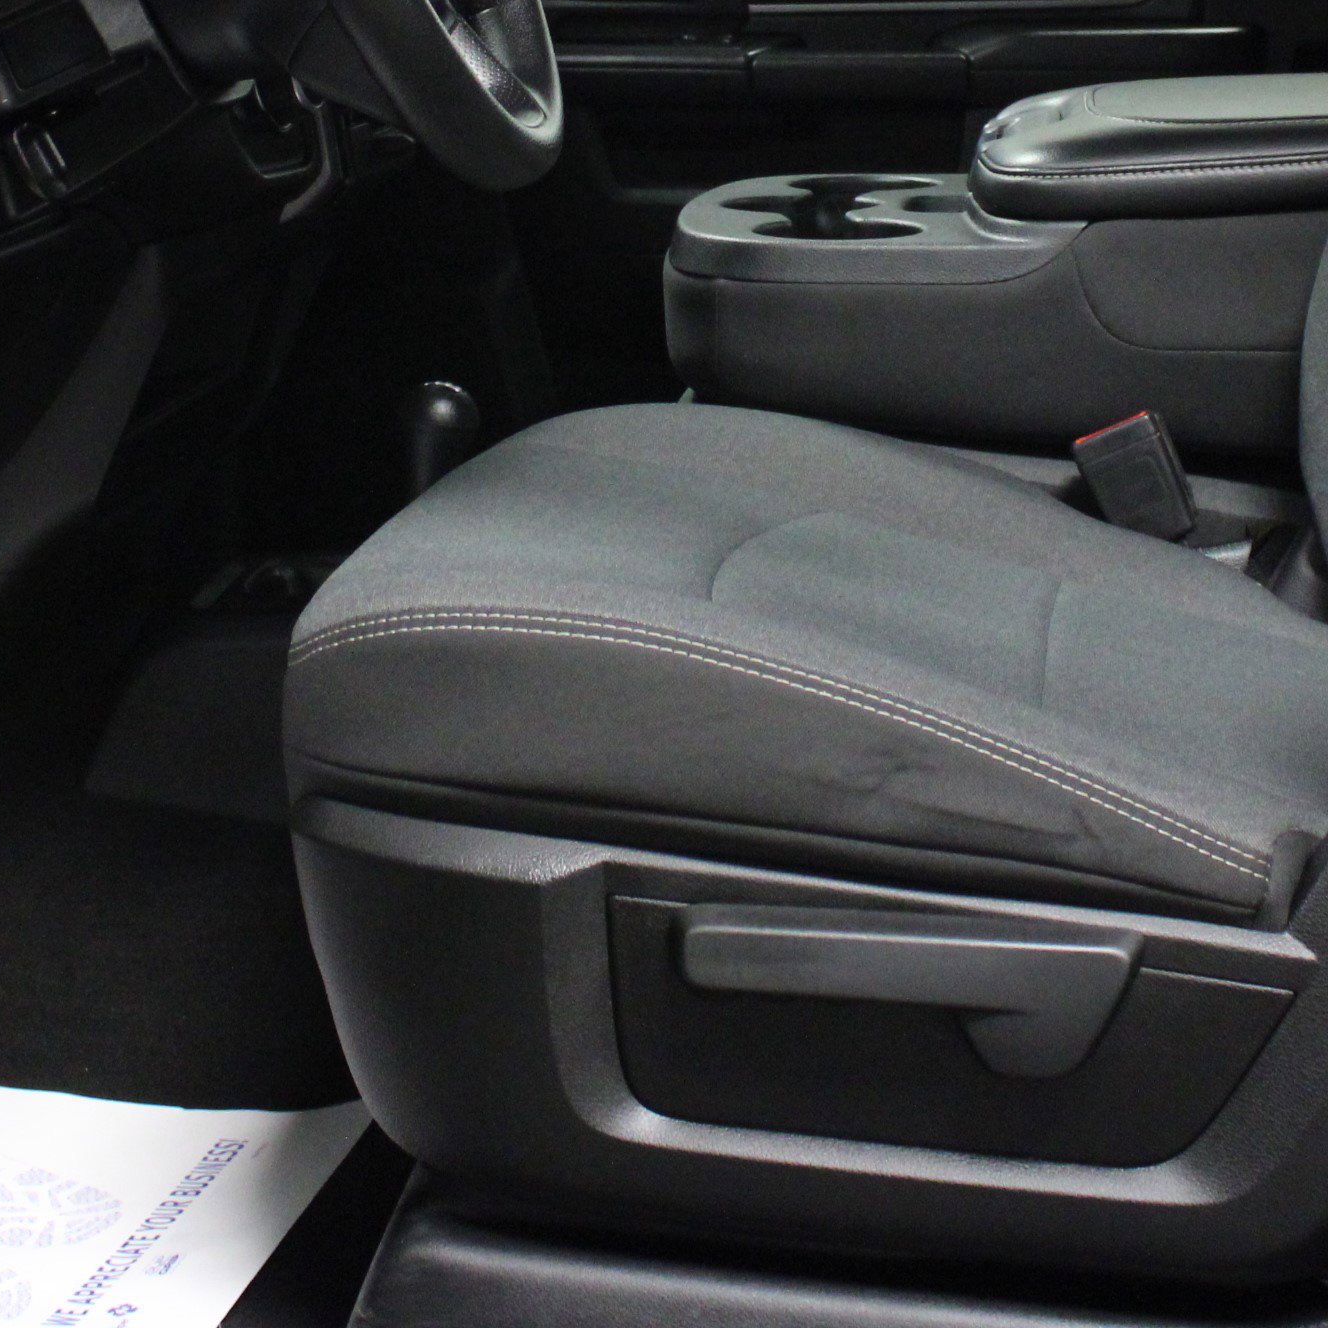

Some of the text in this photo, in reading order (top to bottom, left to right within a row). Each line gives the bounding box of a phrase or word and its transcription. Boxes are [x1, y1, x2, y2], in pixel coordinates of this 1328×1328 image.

[41, 1308, 89, 1327] WE
[68, 1234, 161, 1305] APPRECIATE
[136, 1199, 193, 1232] YOUR
[169, 1138, 249, 1198] BUSINESS!
